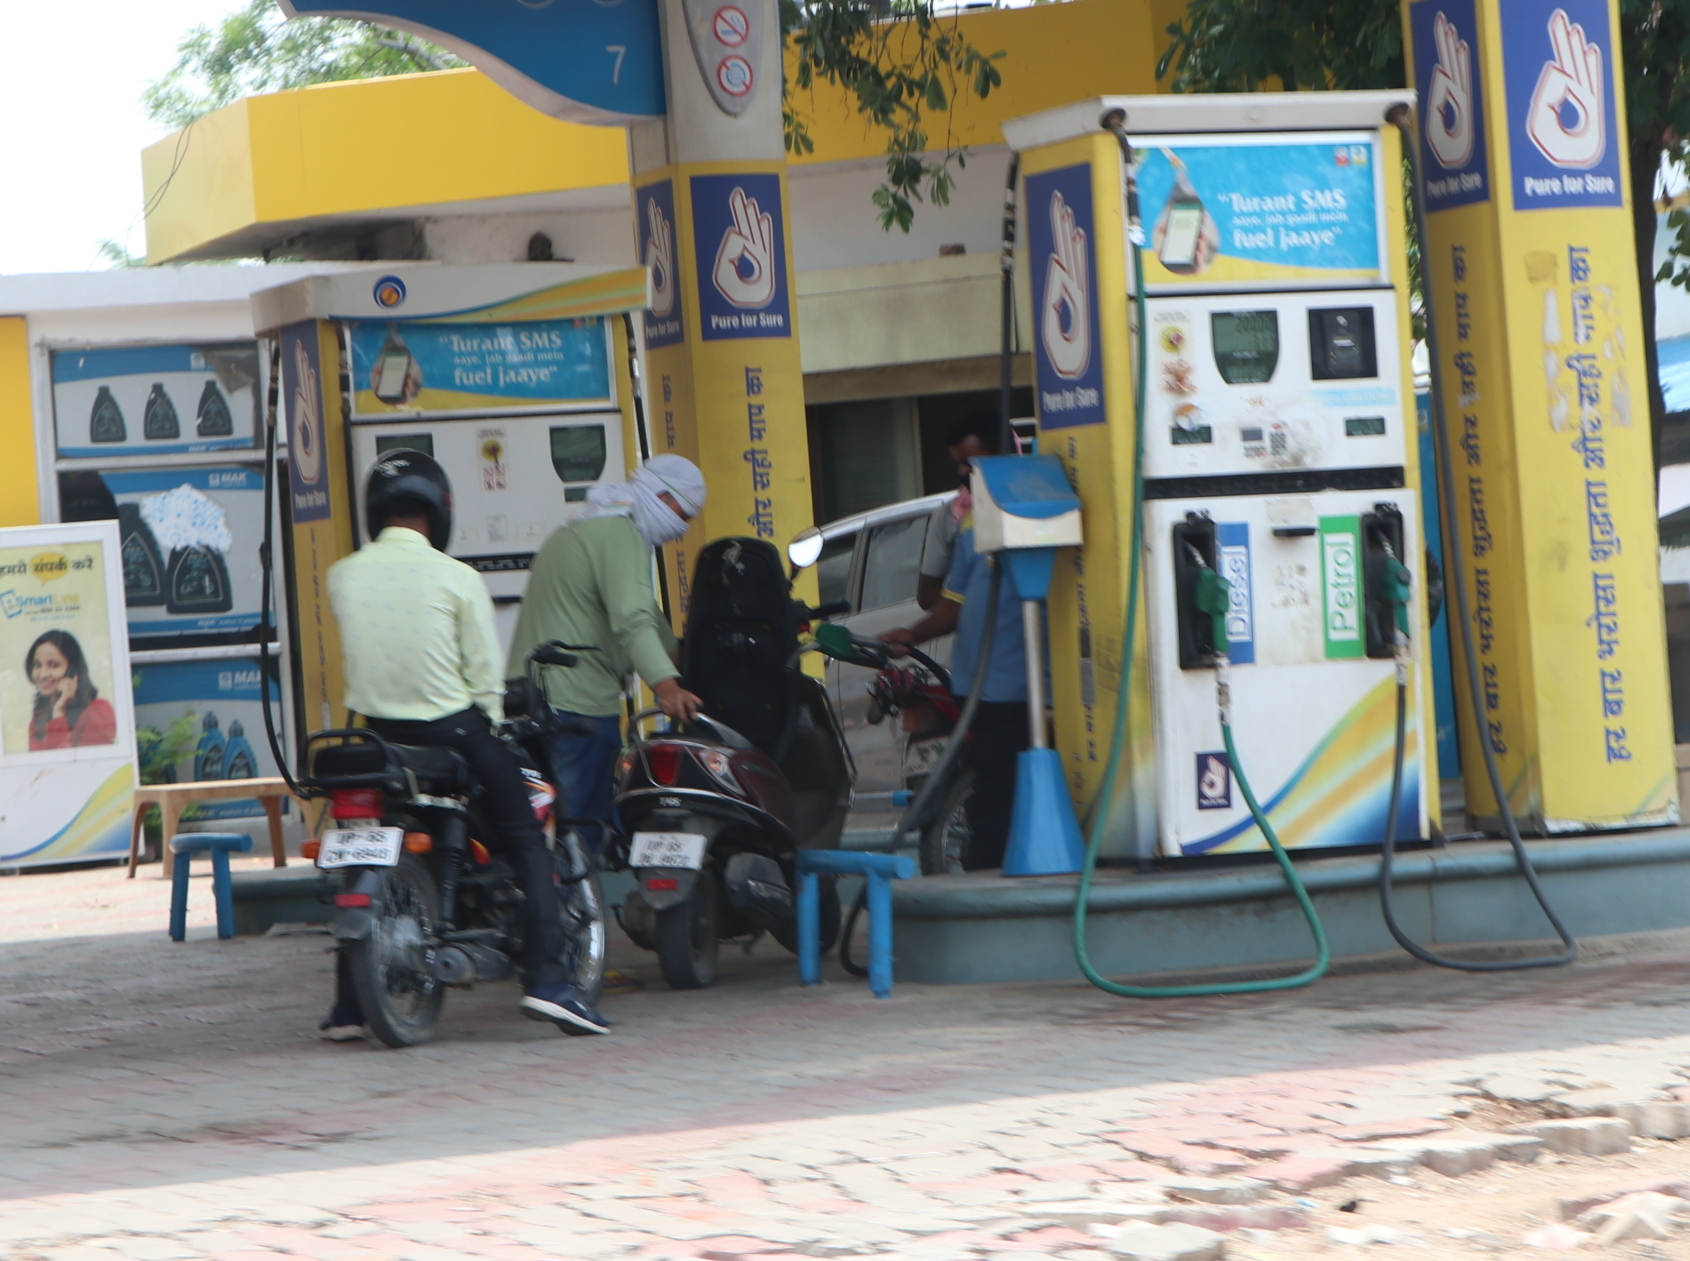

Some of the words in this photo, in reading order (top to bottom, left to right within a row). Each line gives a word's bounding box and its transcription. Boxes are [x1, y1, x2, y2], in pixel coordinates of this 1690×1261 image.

[606, 45, 627, 85] 7
[1301, 188, 1348, 210] SMS
[1524, 176, 1562, 198] Pure
[1563, 174, 1585, 195] for
[1585, 173, 1616, 194] Sure
[1233, 227, 1275, 249] fuel
[1451, 244, 1467, 284] का
[1567, 244, 1592, 285] का
[520, 331, 563, 349] SMS
[711, 314, 740, 330] Pure
[741, 312, 759, 329] for
[759, 311, 783, 328] Sure
[454, 366, 492, 386] fuel
[485, 352, 502, 363] jab
[537, 350, 564, 361] mein
[744, 365, 764, 397] का
[1566, 352, 1604, 409] सही
[747, 402, 769, 443] माप
[221, 471, 248, 482] MAK
[743, 447, 773, 493] सही
[747, 496, 775, 539] और
[1585, 478, 1622, 563] शुद्धता
[1222, 546, 1250, 636] Diesel
[1327, 539, 1357, 632] Petrol
[1472, 567, 1496, 655] भरोसा
[1586, 571, 1621, 660] भरोसा
[1479, 662, 1500, 712] बार
[1600, 668, 1625, 719] बार
[1605, 727, 1632, 764] हर
